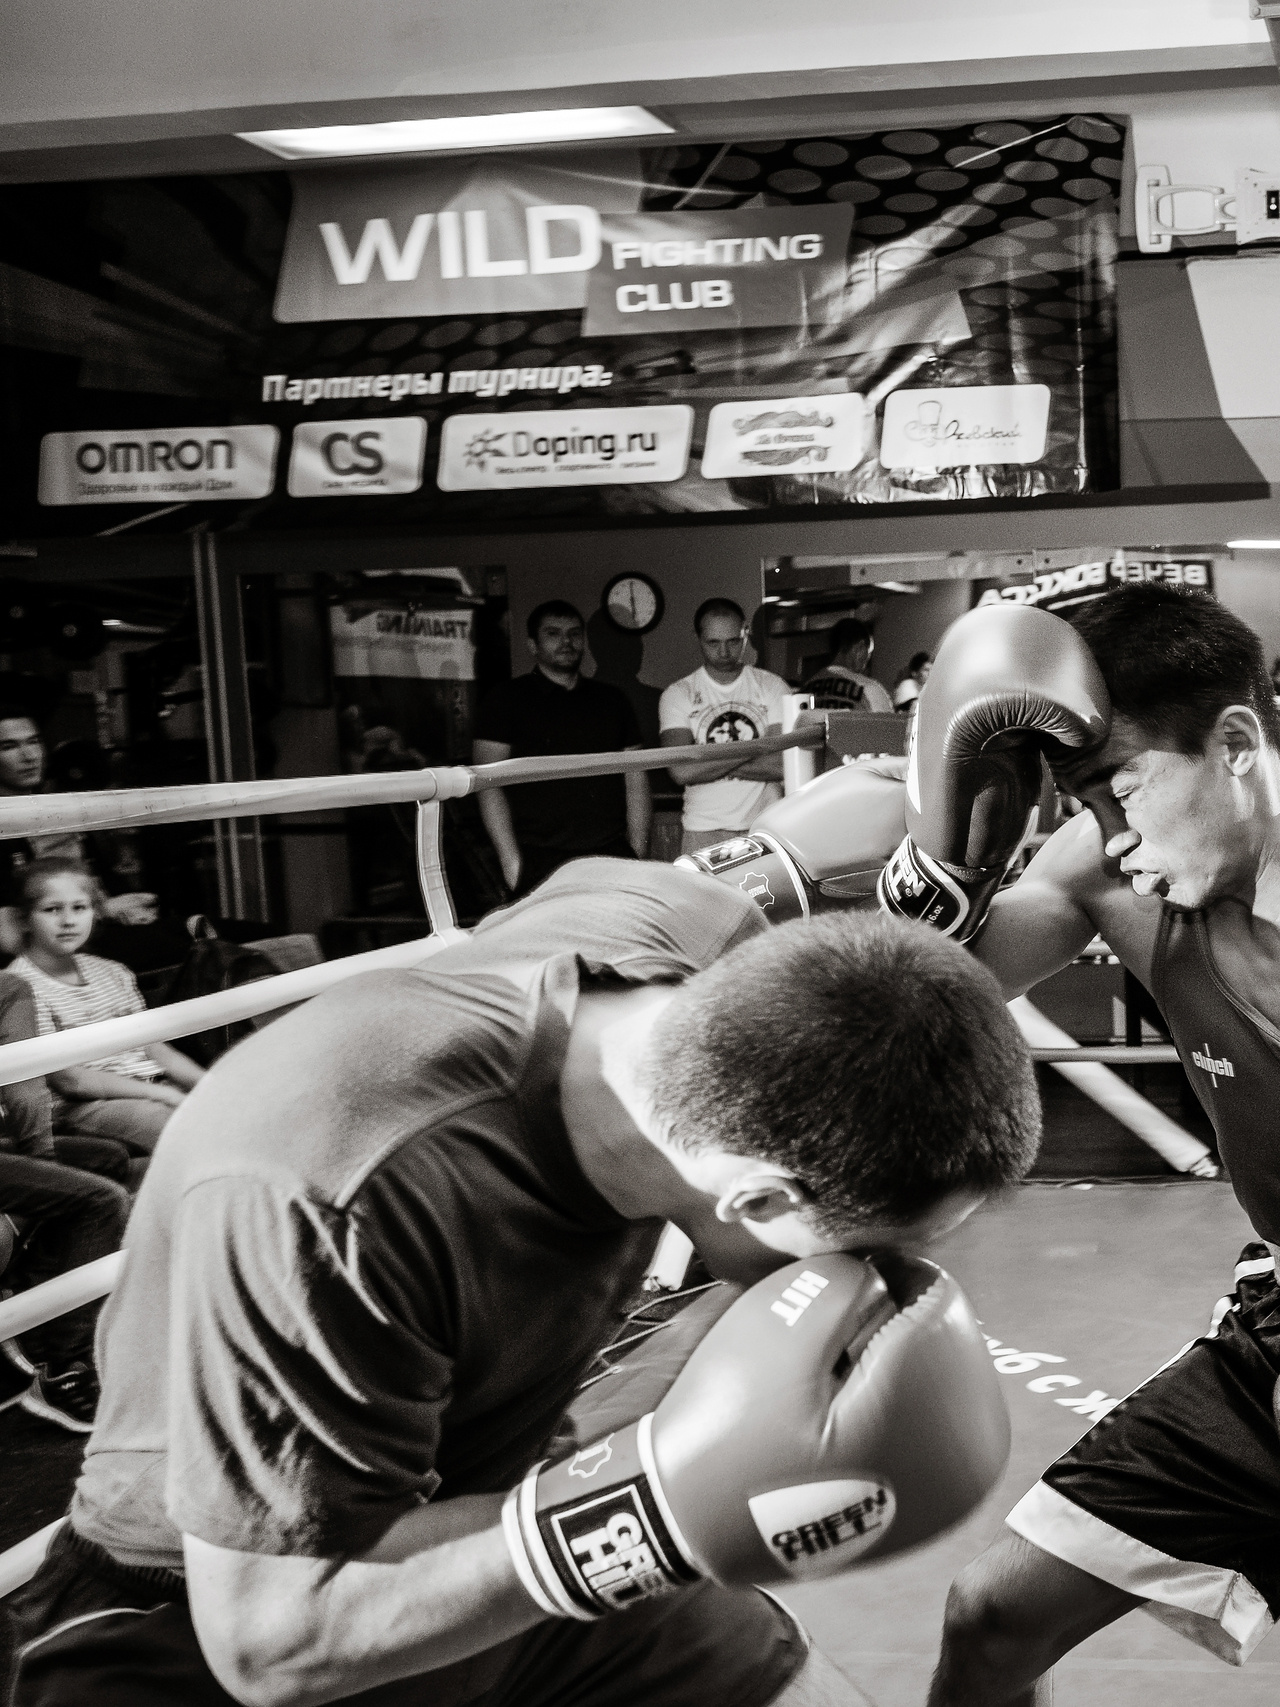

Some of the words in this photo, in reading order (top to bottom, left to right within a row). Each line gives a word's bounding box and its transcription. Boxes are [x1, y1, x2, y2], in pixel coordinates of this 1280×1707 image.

[319, 205, 601, 286] WILD
[613, 232, 824, 270] FIGHTING
[616, 278, 734, 314] CLUB
[262, 368, 444, 405] Партнеры
[447, 363, 613, 398] турнира:
[320, 431, 384, 476] CS
[512, 426, 658, 461] Doping.ru
[770, 1269, 830, 1328] HIT
[771, 1488, 888, 1548] GREEN
